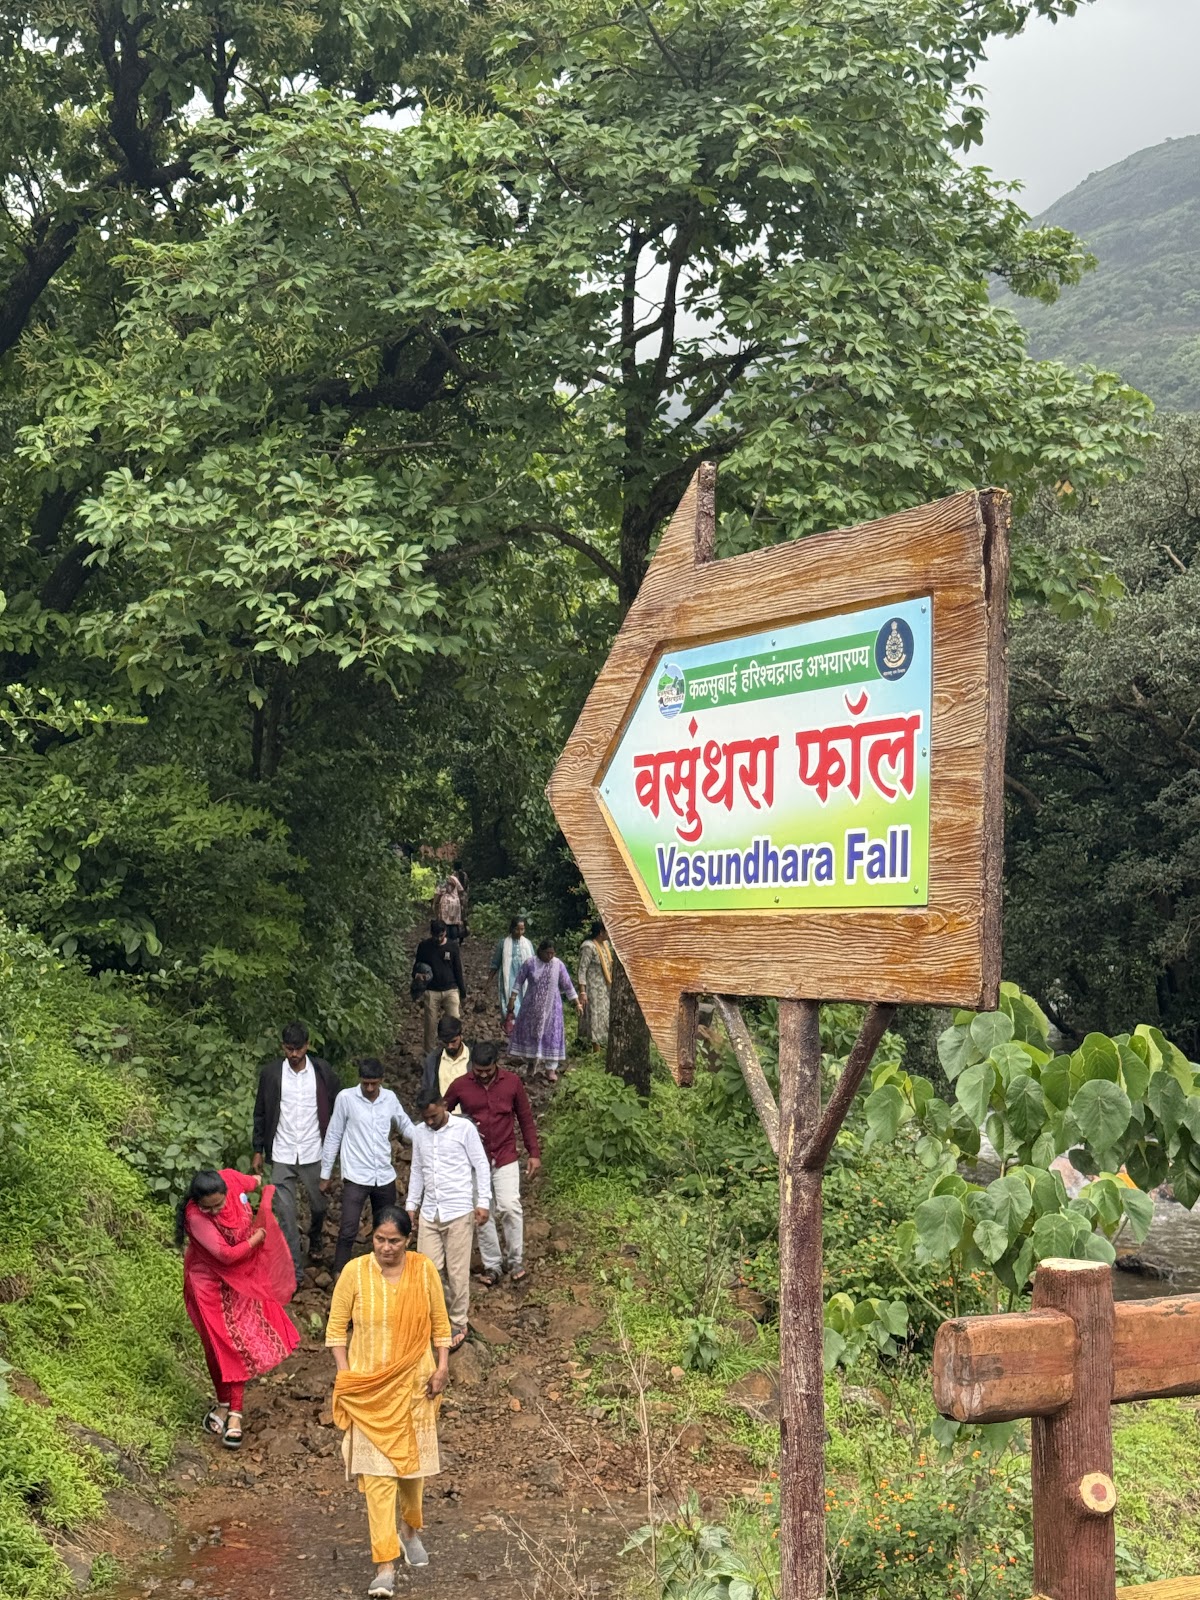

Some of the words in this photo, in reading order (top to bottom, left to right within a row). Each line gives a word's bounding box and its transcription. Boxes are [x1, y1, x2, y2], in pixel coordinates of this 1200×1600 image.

[688, 664, 737, 703] कळसुबाई
[740, 656, 803, 690] हरिश्चंद्रगड
[807, 645, 870, 677] अभयारण्य
[633, 717, 779, 840] वसुंधरा
[795, 691, 920, 803] फॉल
[657, 839, 833, 887] Vasundhara
[846, 829, 909, 879] Fall
